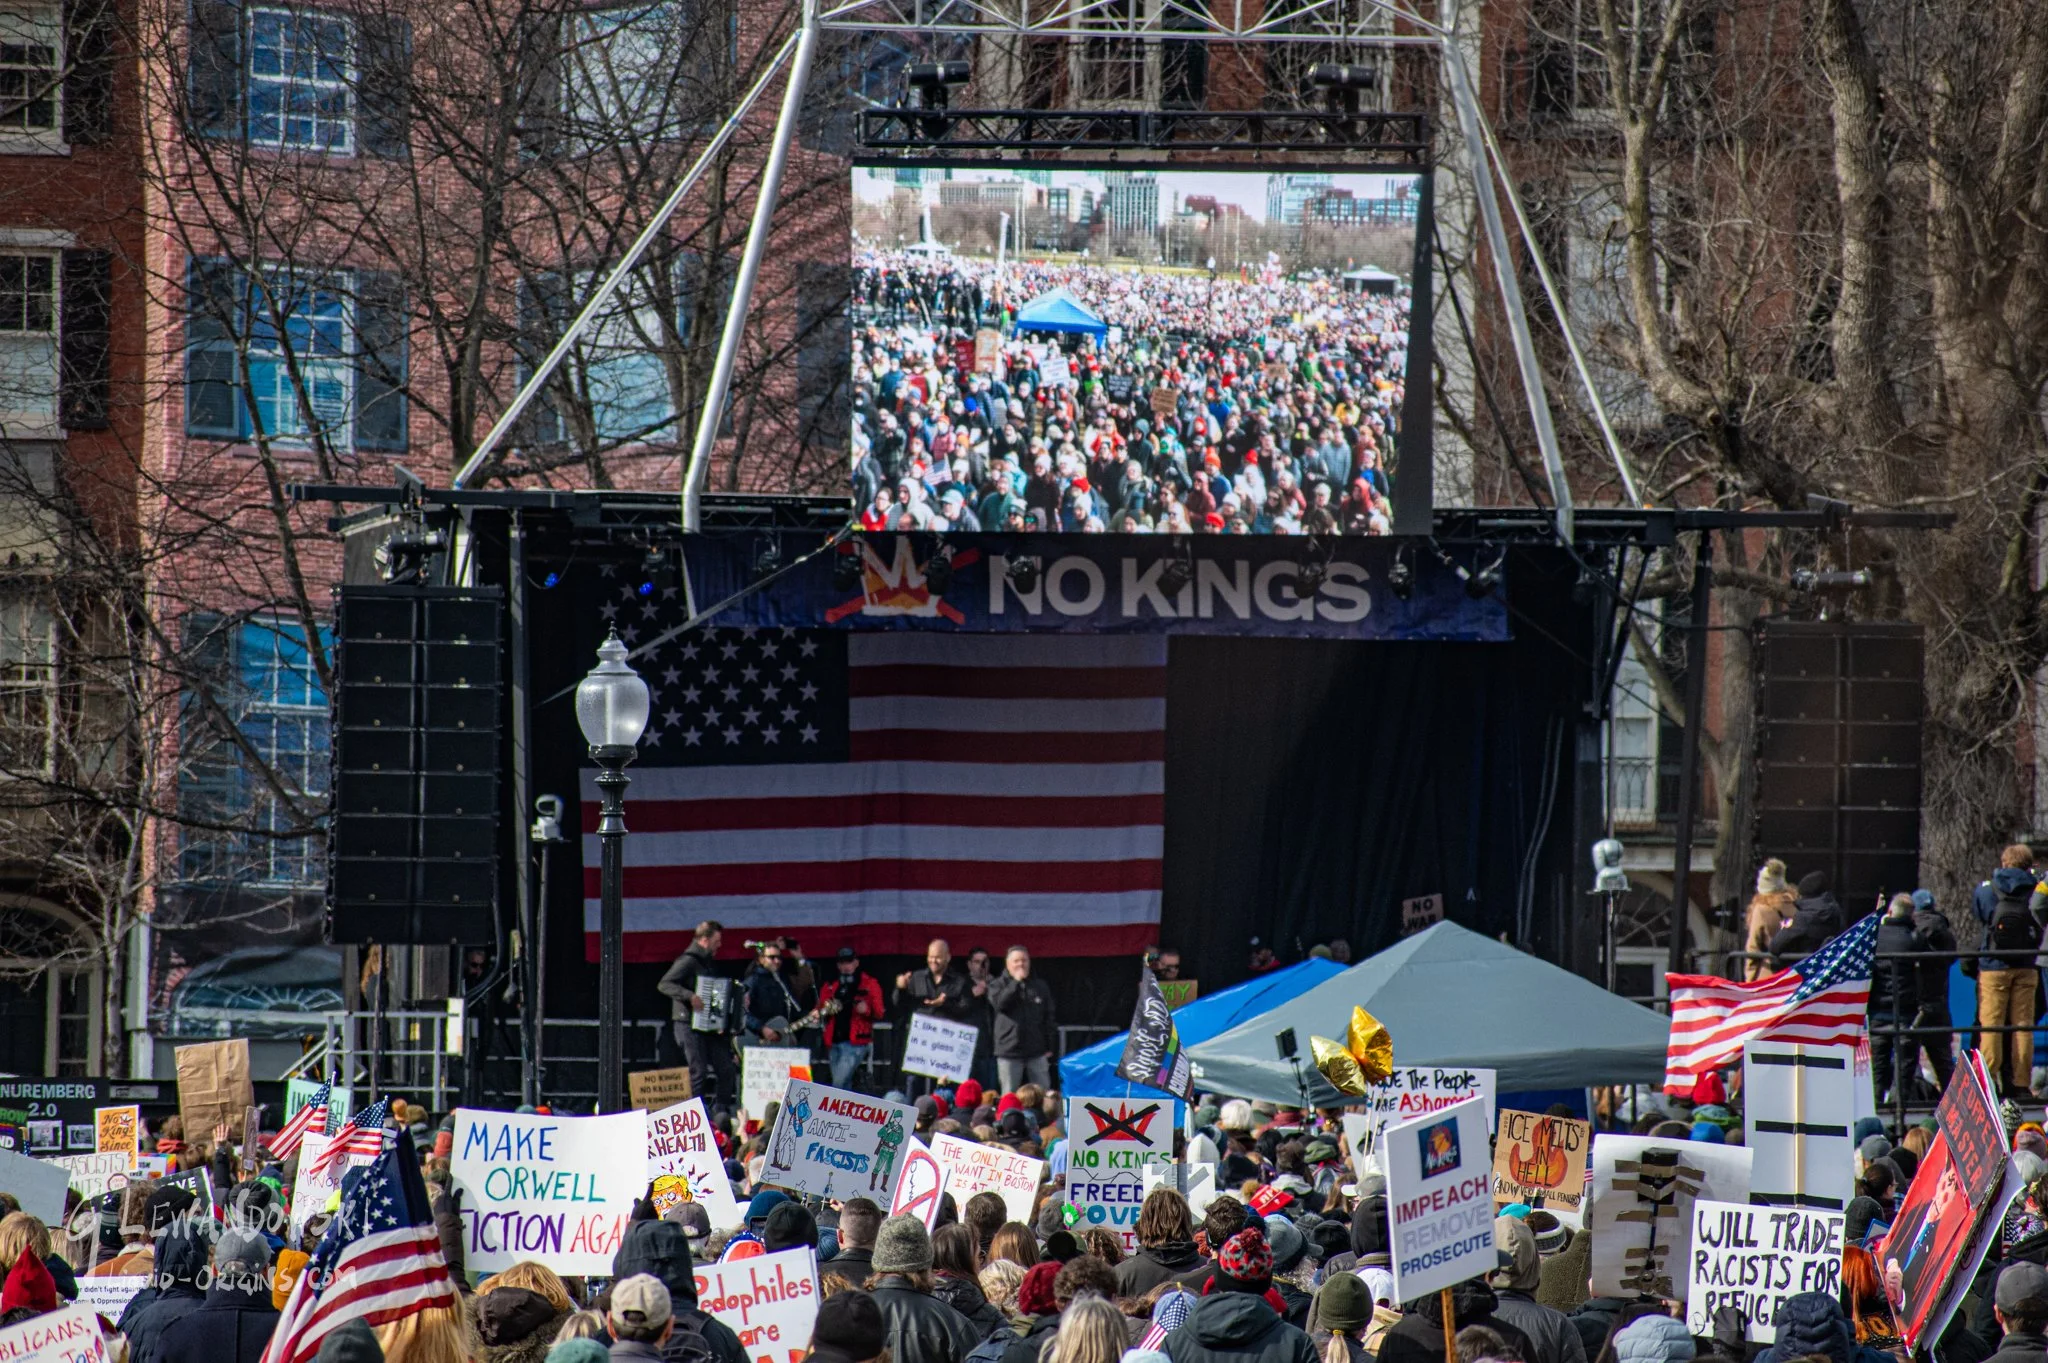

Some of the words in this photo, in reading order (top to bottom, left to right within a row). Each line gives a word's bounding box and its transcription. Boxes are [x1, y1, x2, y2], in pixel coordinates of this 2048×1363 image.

[988, 555, 1105, 616] NO
[1121, 556, 1371, 623] KINGS
[1411, 898, 1434, 914] NO
[911, 1036, 918, 1044] in
[931, 1042, 954, 1052] glass
[922, 1022, 937, 1032] like
[942, 1028, 955, 1037] my
[959, 1031, 976, 1043] ICE
[907, 1056, 925, 1065] with
[640, 1086, 651, 1094] NO
[653, 1083, 684, 1092] KILLERS
[644, 1075, 656, 1083] NO
[1407, 1069, 1429, 1090] The
[1434, 1069, 1481, 1093] People
[0, 1084, 96, 1099] NUREMBERG
[28, 1102, 57, 1117] 2.0
[818, 1097, 889, 1125] AMERICAN
[1957, 1072, 1997, 1155] PUPPET
[99, 1126, 135, 1139] Kings
[654, 1118, 669, 1135] IS
[670, 1109, 701, 1135] BAD
[807, 1118, 857, 1142] ANTI-
[1507, 1113, 1534, 1143] ICE
[1540, 1117, 1580, 1155] MELTS
[100, 1140, 134, 1152] Since
[463, 1121, 558, 1162] MAKE
[654, 1133, 706, 1156] HEALTH
[1945, 1103, 1983, 1194] MASTER
[805, 1142, 870, 1173] FASCISTS
[941, 1141, 963, 1159] THE
[971, 1151, 1001, 1169] ONLY
[1004, 1156, 1028, 1175] ICE
[1072, 1150, 1100, 1168] NO
[1108, 1151, 1172, 1169] KINGS
[1536, 1147, 1550, 1165] IN
[299, 1168, 341, 1192] MINOR
[485, 1167, 606, 1202] ORWELL
[955, 1163, 985, 1179] WANT
[987, 1169, 1002, 1182] IN
[1004, 1174, 1036, 1192] BOSTON
[955, 1179, 968, 1188] IS
[970, 1182, 988, 1192] AT
[1517, 1161, 1552, 1187] HELL
[296, 1192, 327, 1209] DEST
[1071, 1183, 1144, 1203] FREED
[1396, 1174, 1489, 1225] IMPEACH
[1087, 1205, 1141, 1225] OVE
[569, 1213, 631, 1255] AGA
[1403, 1203, 1490, 1254] REMOVE
[1699, 1210, 1758, 1248] WILL
[1770, 1212, 1844, 1256] TRADE
[1401, 1231, 1492, 1278] PROSECUTE
[1695, 1249, 1793, 1290] RACISTS
[1801, 1258, 1841, 1295] FOR
[104, 1286, 119, 1294] fight
[738, 1324, 780, 1347] are
